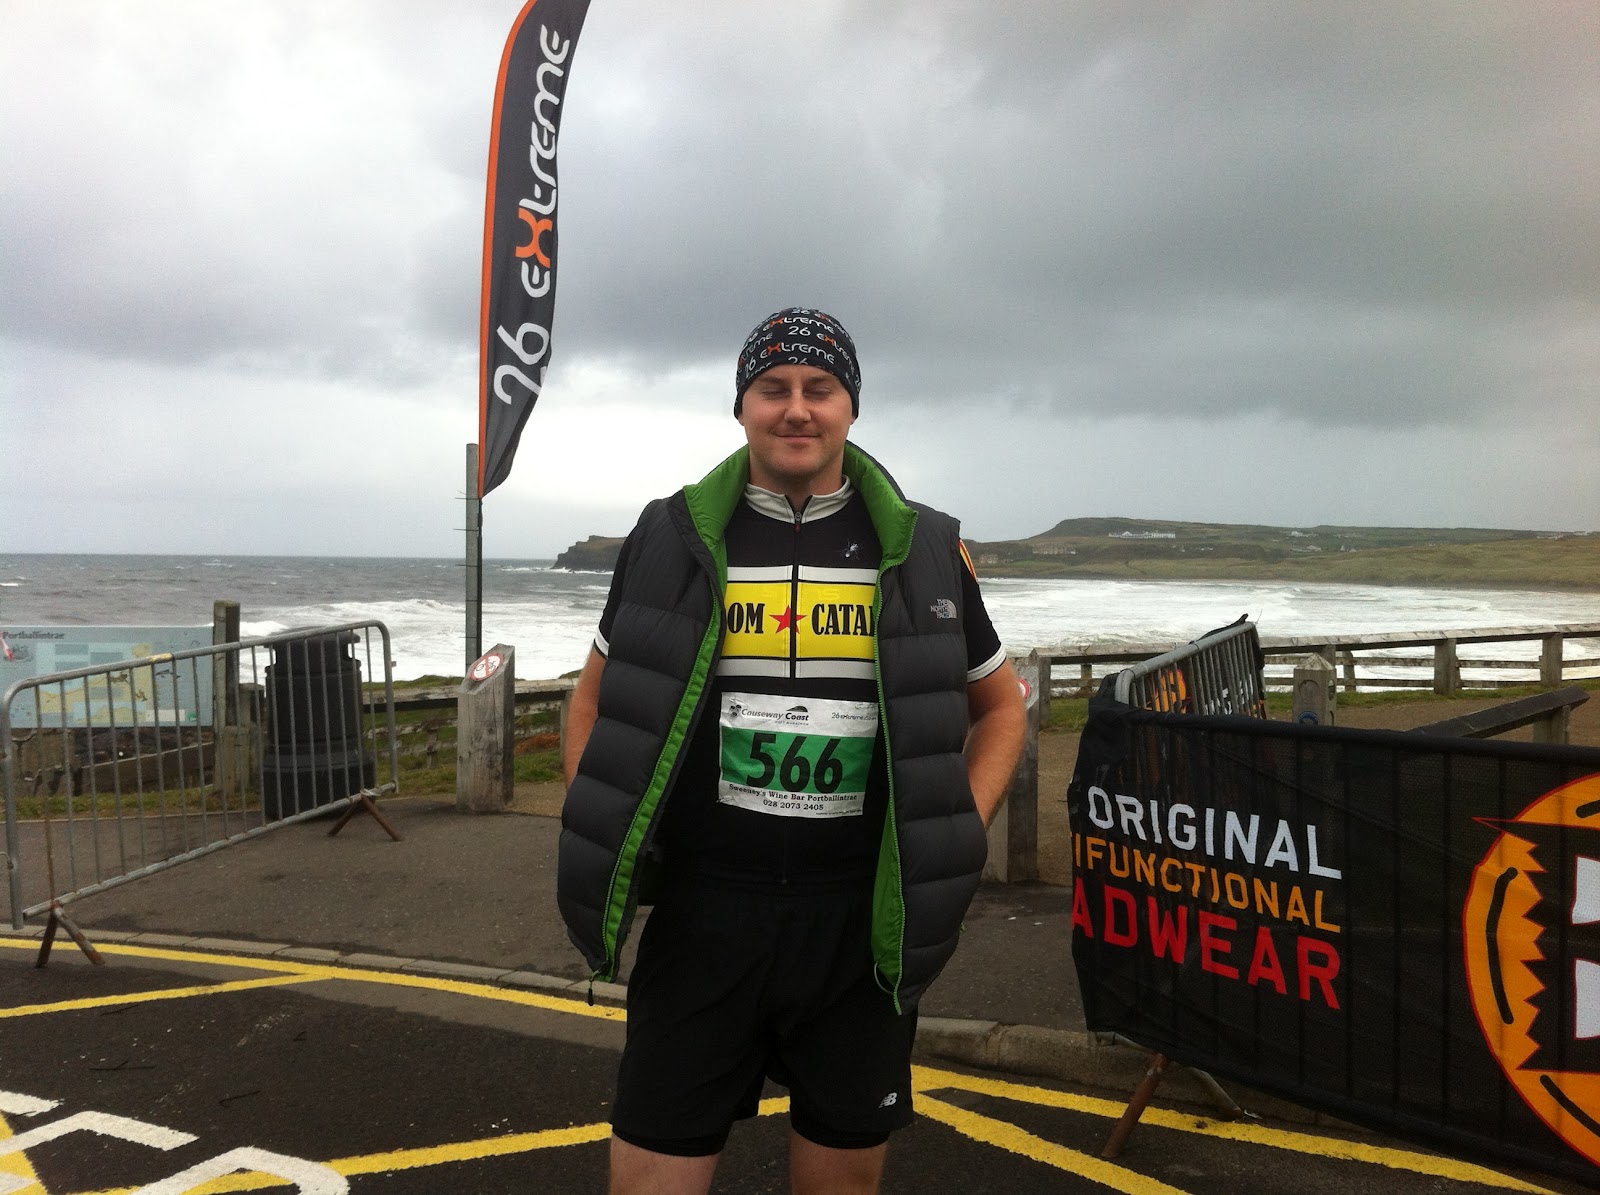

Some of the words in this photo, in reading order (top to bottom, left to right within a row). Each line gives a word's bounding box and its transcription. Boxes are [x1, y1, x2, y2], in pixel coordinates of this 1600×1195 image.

[787, 326, 811, 337] 26
[728, 602, 765, 634] OM
[741, 708, 784, 720] Causeway
[785, 712, 809, 721] Coast
[746, 732, 844, 794] 566
[729, 784, 766, 798] Sweeney's
[768, 791, 789, 800] Wine
[791, 793, 805, 801] Bar
[807, 794, 858, 802] Portballintrae
[763, 799, 778, 808] 028
[780, 801, 801, 810] 2073
[803, 803, 824, 811] 2405
[1087, 785, 1343, 881] ORIGINAL
